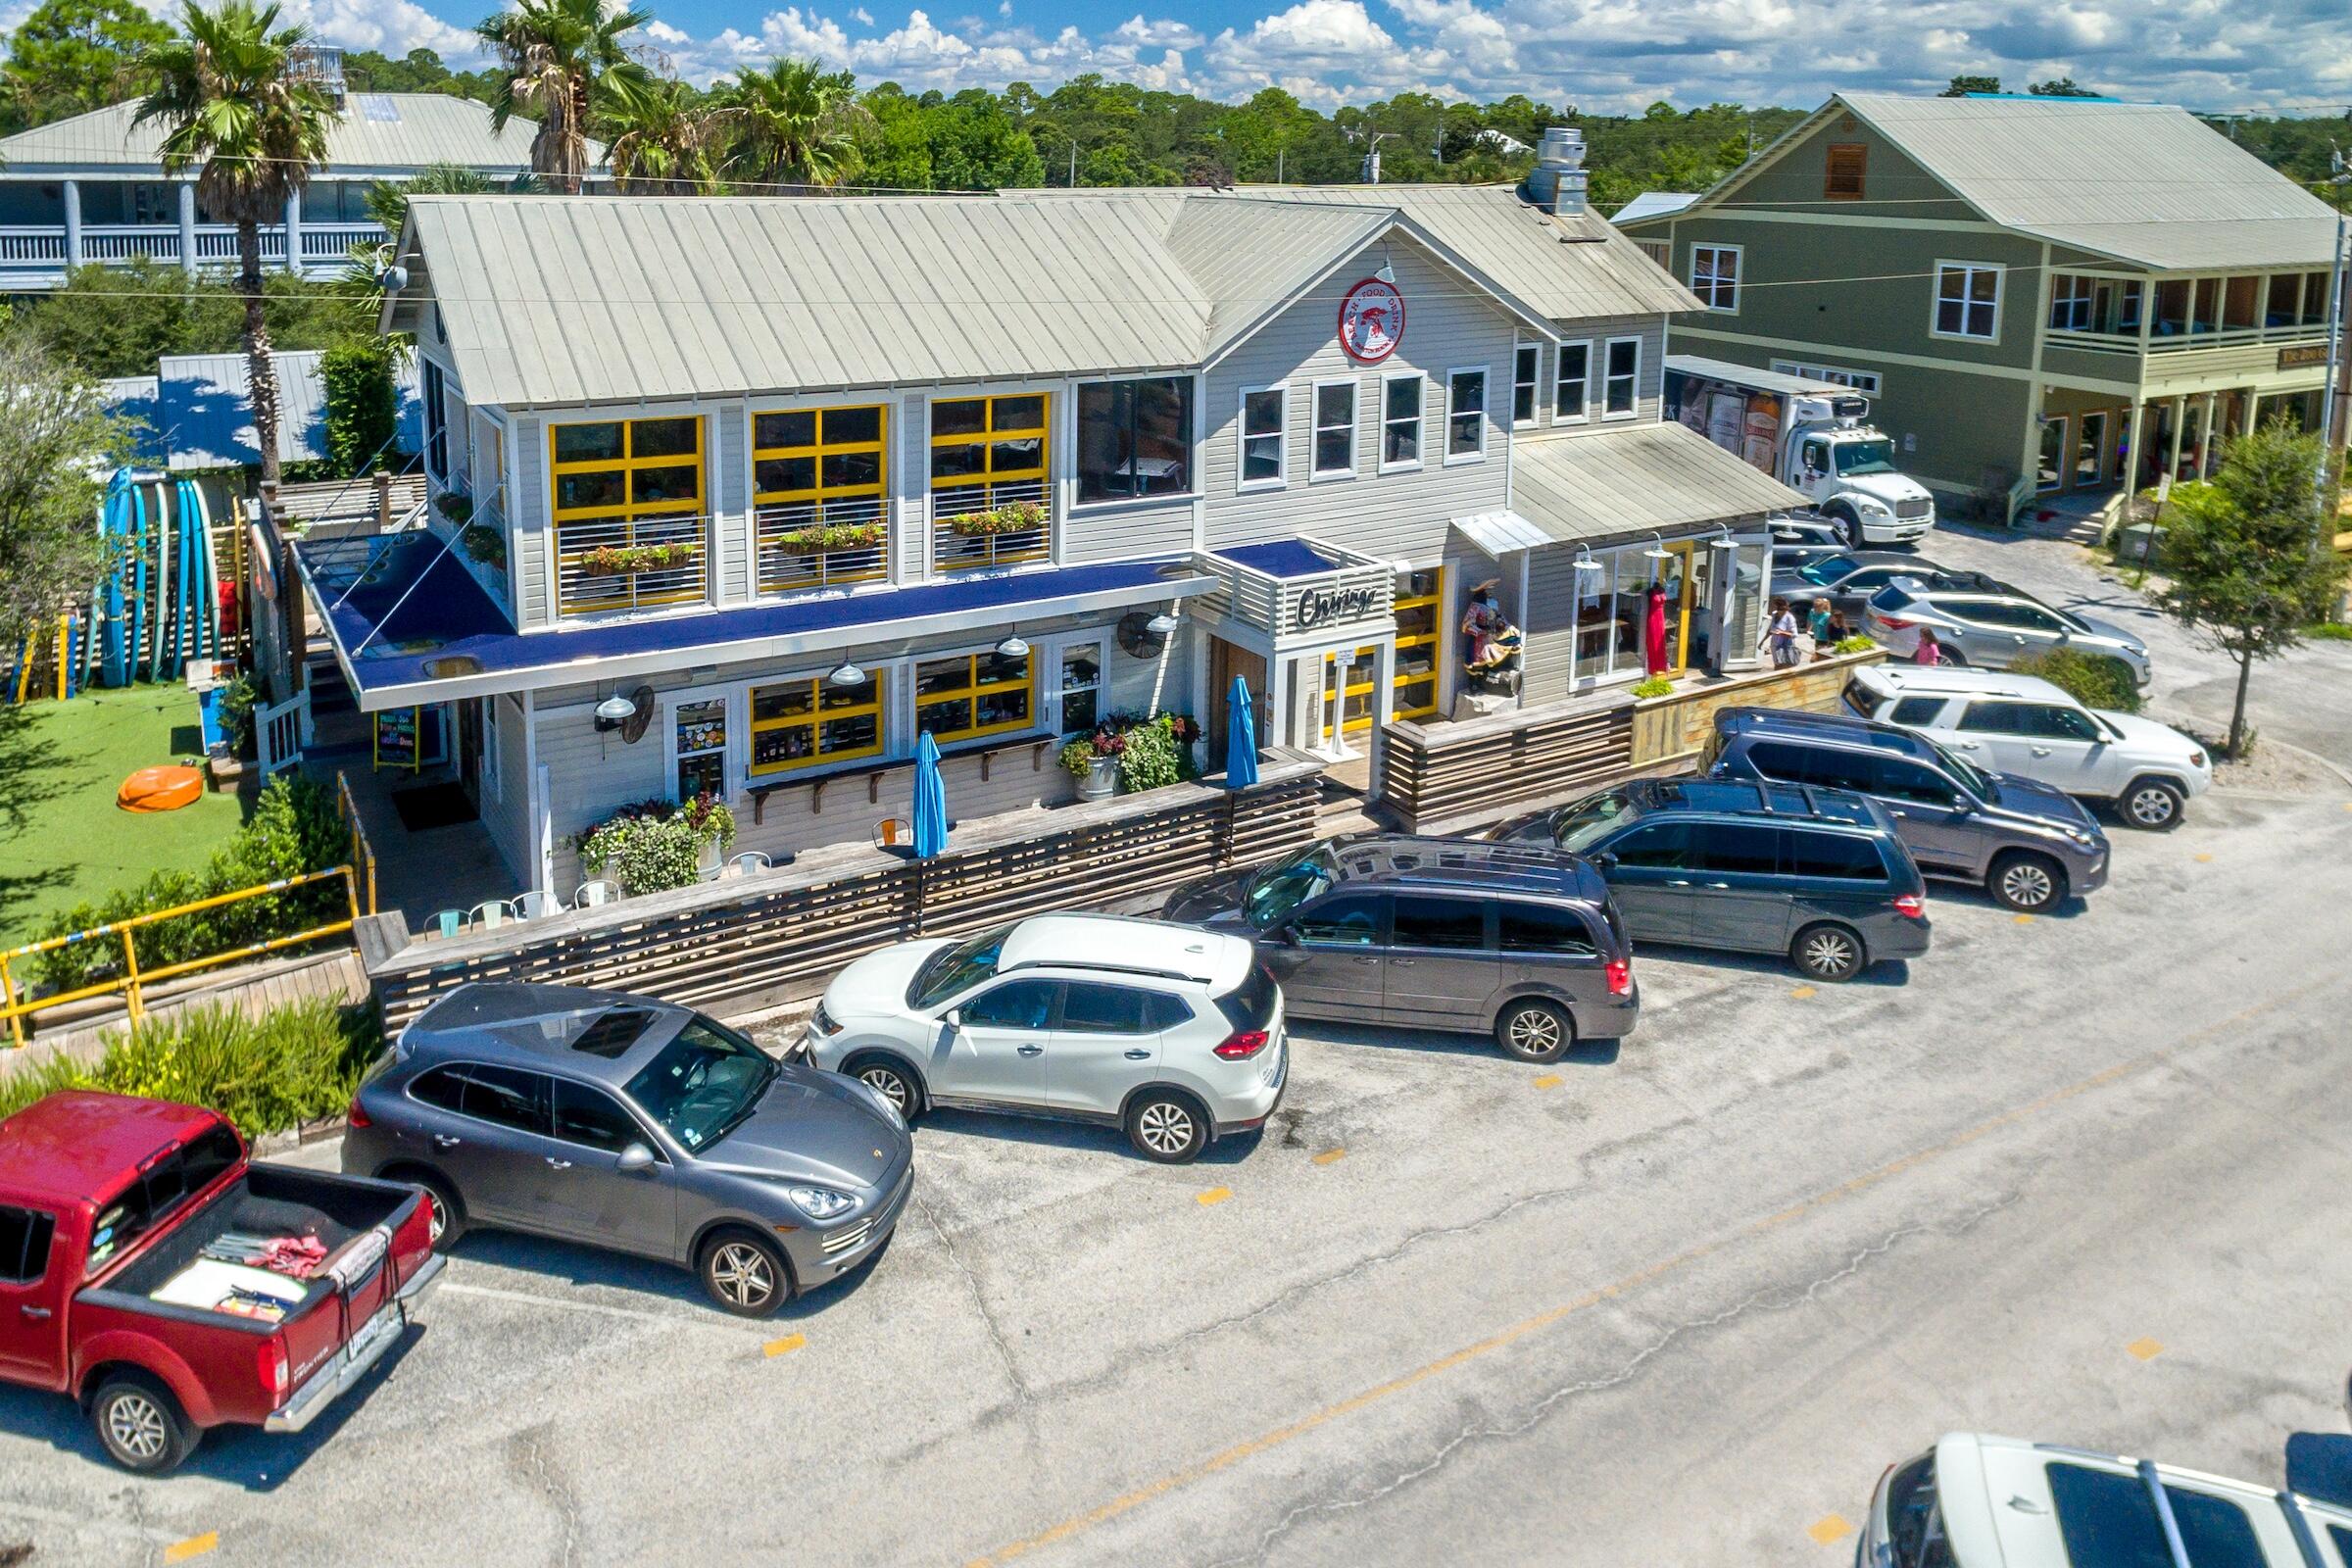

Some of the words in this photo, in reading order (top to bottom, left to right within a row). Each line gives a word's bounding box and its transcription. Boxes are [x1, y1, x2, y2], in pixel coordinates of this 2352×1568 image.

[1348, 303, 1359, 340] BEACH
[1388, 298, 1399, 331] DRINK
[1298, 588, 1377, 627] Chiringo
[293, 1346, 329, 1384] FRONTIER
